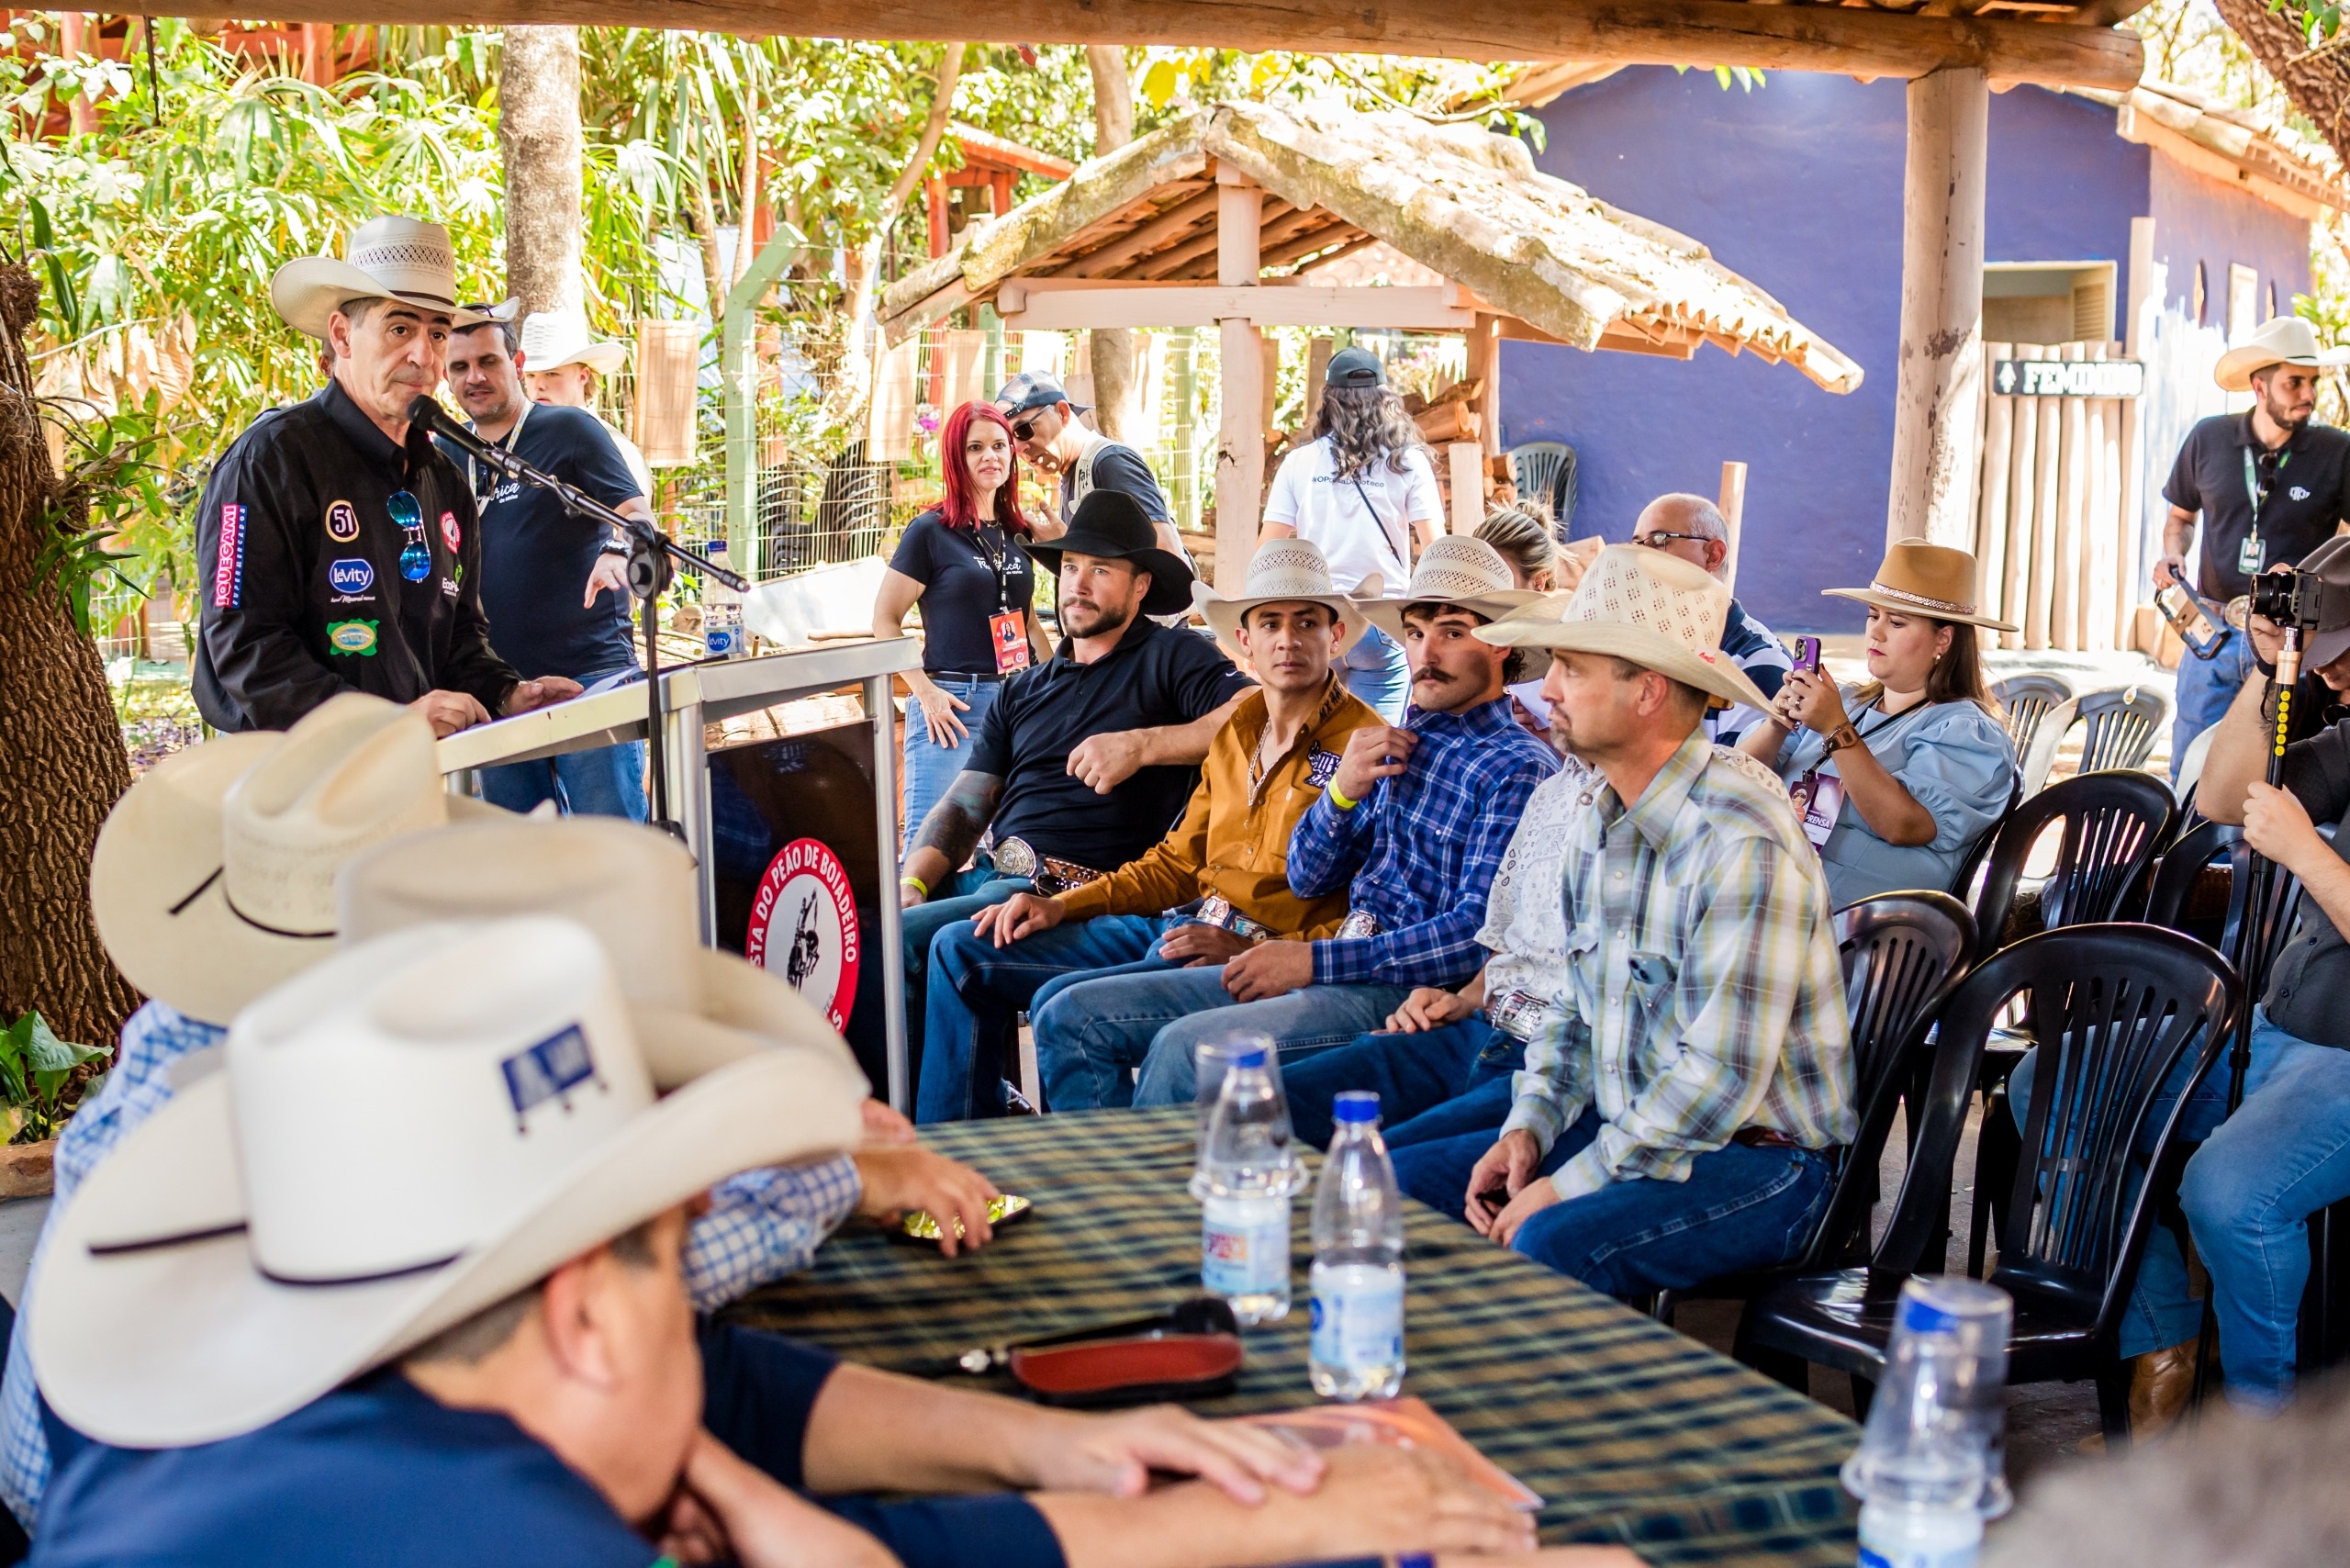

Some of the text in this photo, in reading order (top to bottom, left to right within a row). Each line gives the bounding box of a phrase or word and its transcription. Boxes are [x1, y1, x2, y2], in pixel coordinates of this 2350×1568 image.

[215, 505, 237, 606] IQUEGAMI
[232, 507, 246, 606] SUPERMERCADOS
[333, 509, 354, 533] 51
[1806, 813, 1830, 828] PRENSA
[749, 844, 857, 968] STA DO PEÃO DE BOIADEIRO
